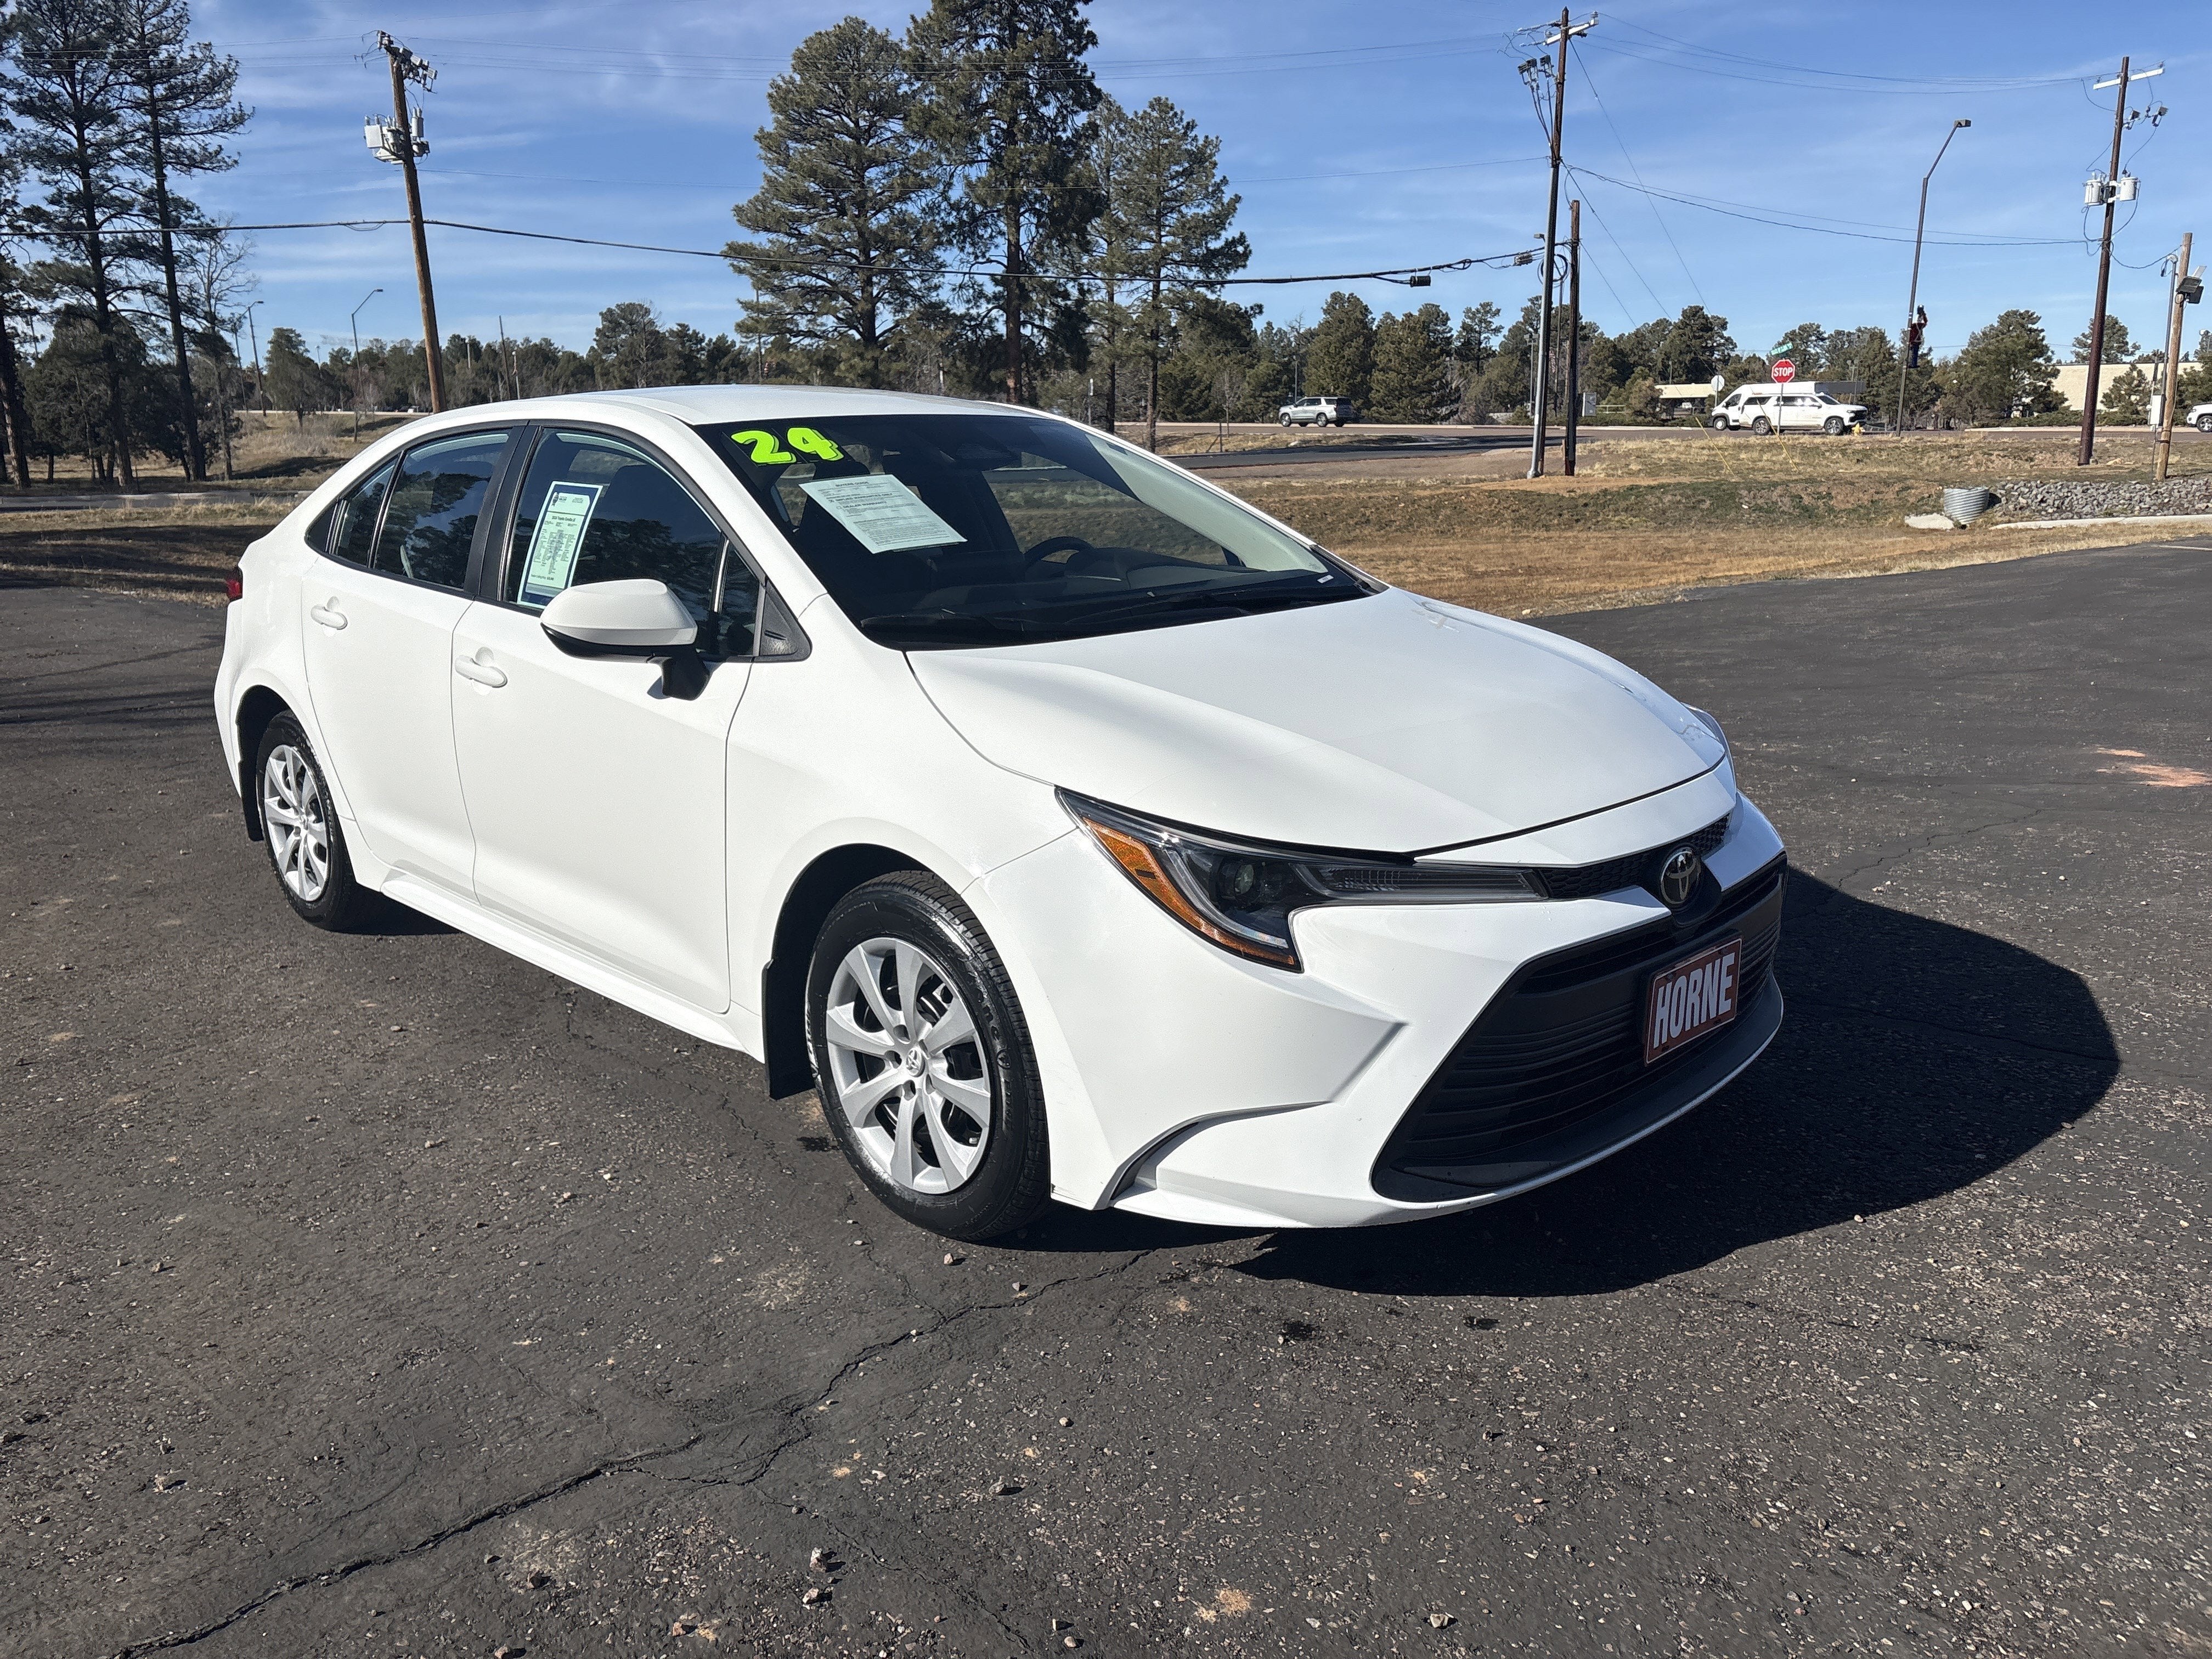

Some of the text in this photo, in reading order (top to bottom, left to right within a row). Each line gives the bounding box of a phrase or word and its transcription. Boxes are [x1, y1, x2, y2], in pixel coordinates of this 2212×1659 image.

[1774, 367, 1793, 377] STOP
[731, 427, 844, 464] 24
[1653, 952, 1735, 1049] HORNE
